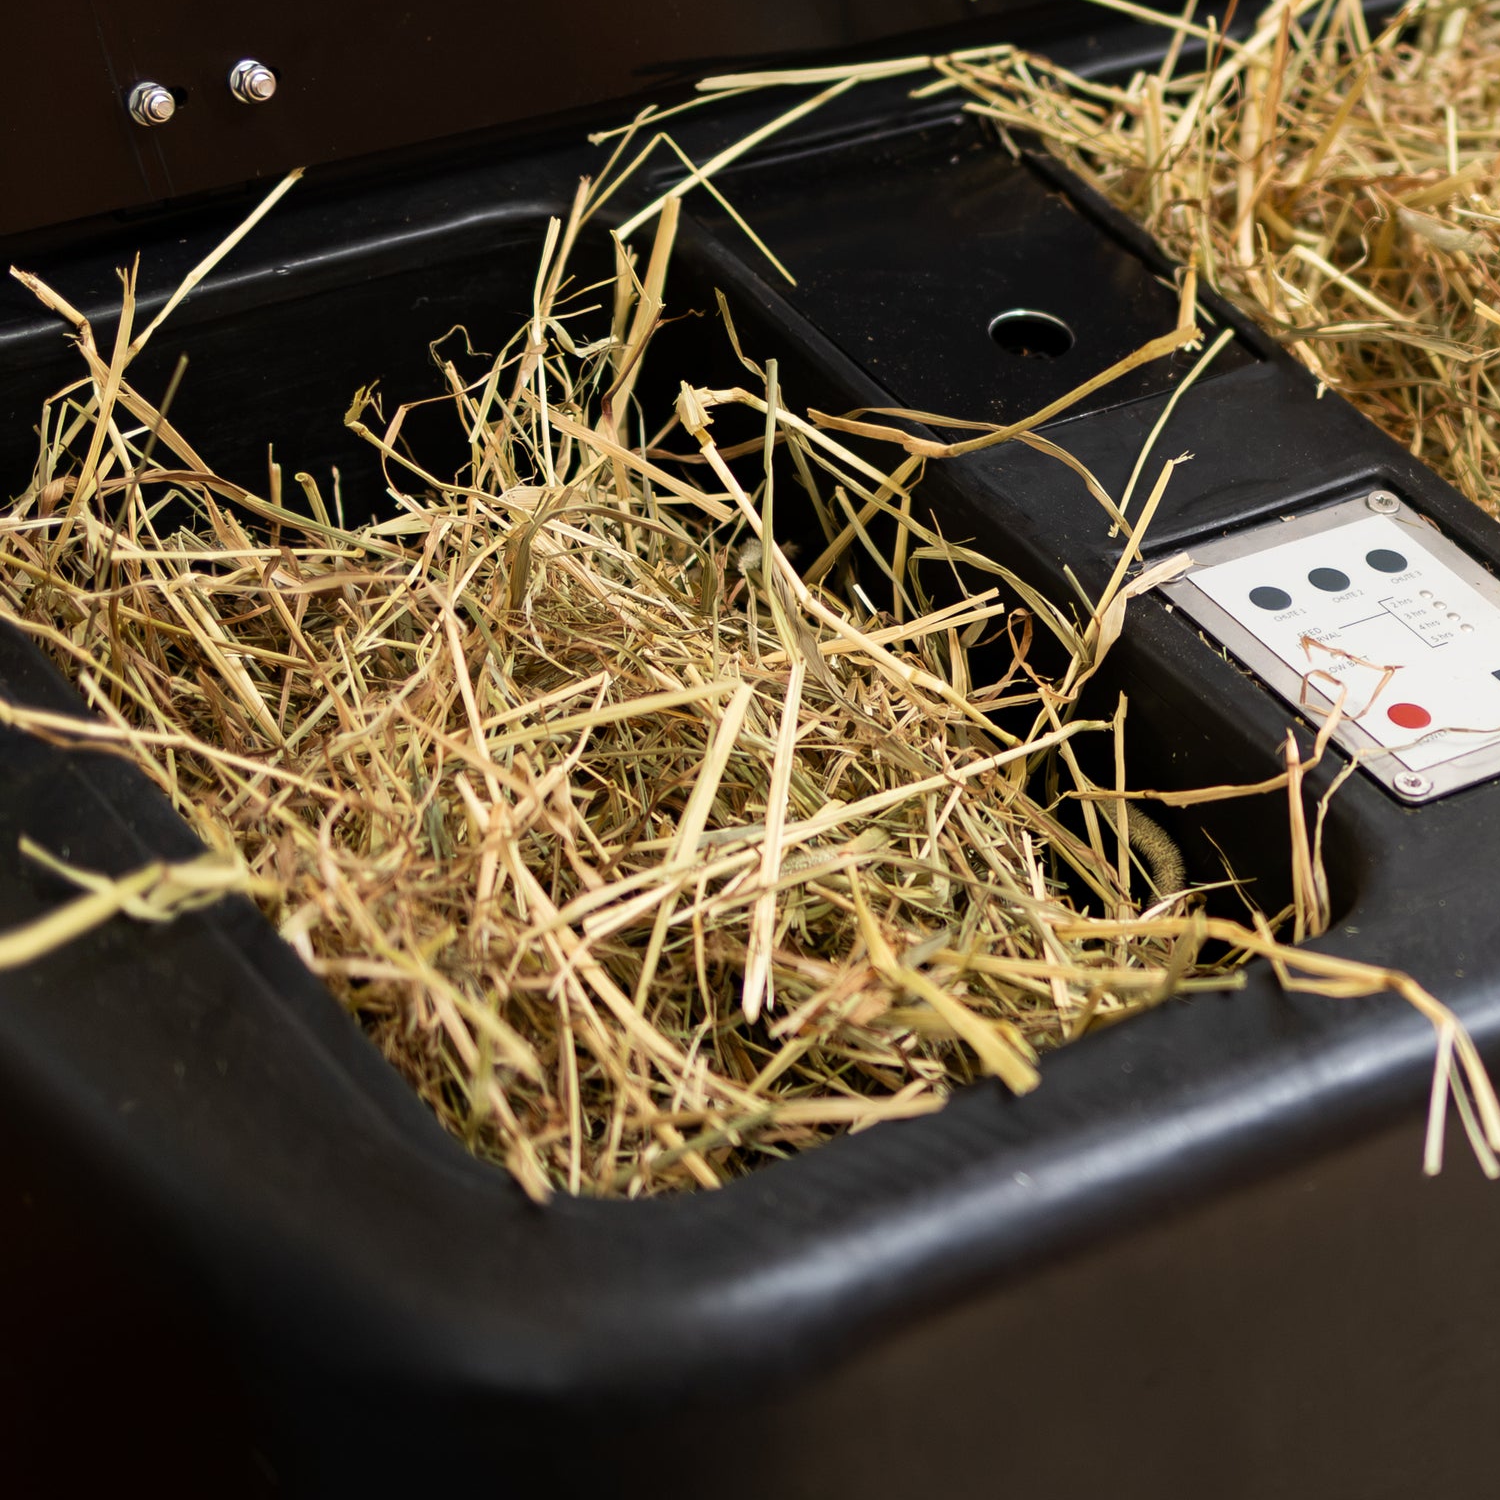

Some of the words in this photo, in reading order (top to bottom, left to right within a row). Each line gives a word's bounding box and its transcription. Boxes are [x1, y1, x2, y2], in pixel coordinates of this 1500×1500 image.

[1390, 572, 1415, 584] CHUTE
[1332, 591, 1357, 604] CHUTE
[1397, 598, 1413, 606] hrs
[1273, 610, 1302, 622] CHUTE
[1425, 620, 1440, 628] hrs
